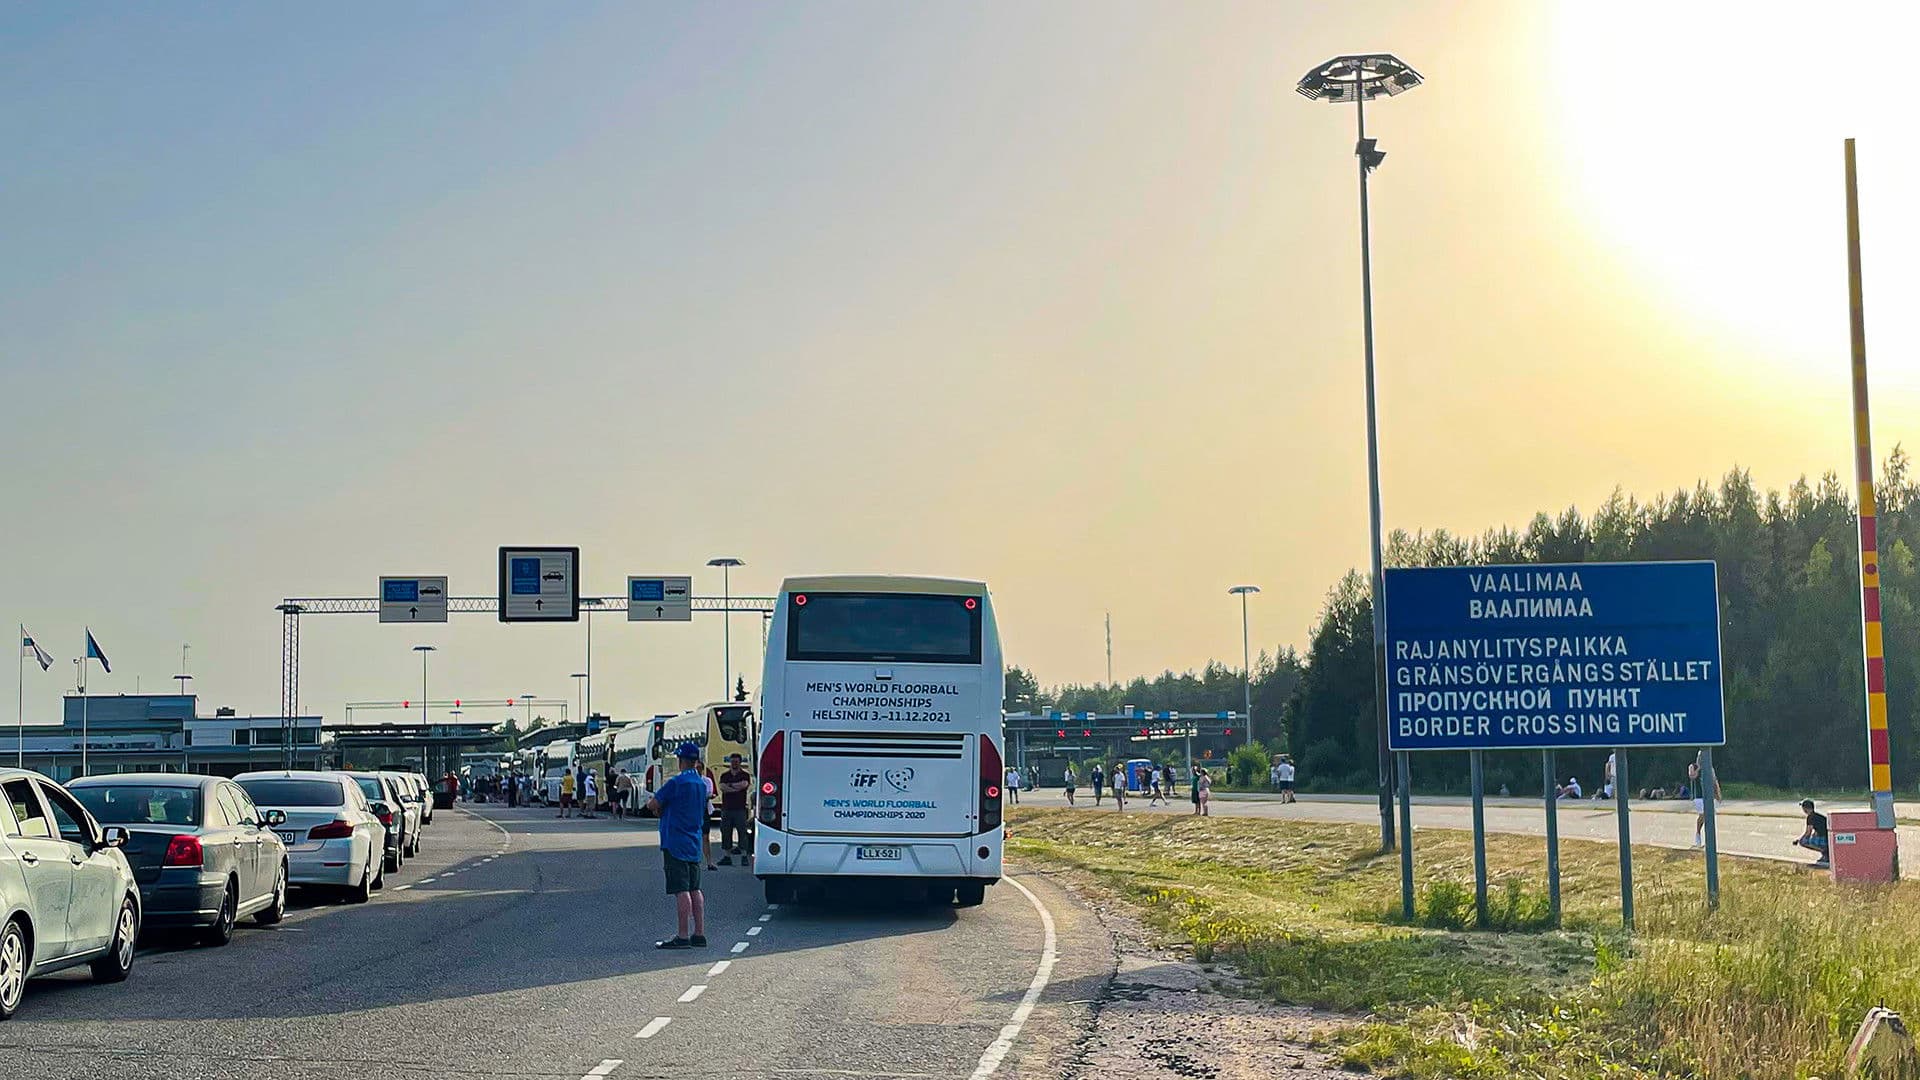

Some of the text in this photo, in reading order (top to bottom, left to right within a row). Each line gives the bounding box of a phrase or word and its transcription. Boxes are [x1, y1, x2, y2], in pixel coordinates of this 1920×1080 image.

[1469, 572, 1583, 592] VAALIMAA
[1470, 597, 1593, 619] ВААЛИМАА
[1396, 636, 1628, 660] RAJANYLITYSPAIKKA
[806, 682, 959, 695] MEN'S WORLD FLOORBALL
[832, 697, 932, 708] CHAMPIONSHIPS
[1399, 687, 1641, 712] ПРОПУСКНОЙ ПУНКТ
[812, 710, 868, 721] HELSINKI
[1400, 712, 1687, 737] BORDER CROSSING POINT
[823, 799, 937, 809] MEN'S WORLD FLOORBALL
[834, 810, 926, 819] CHAMPIONSHIPS 2020
